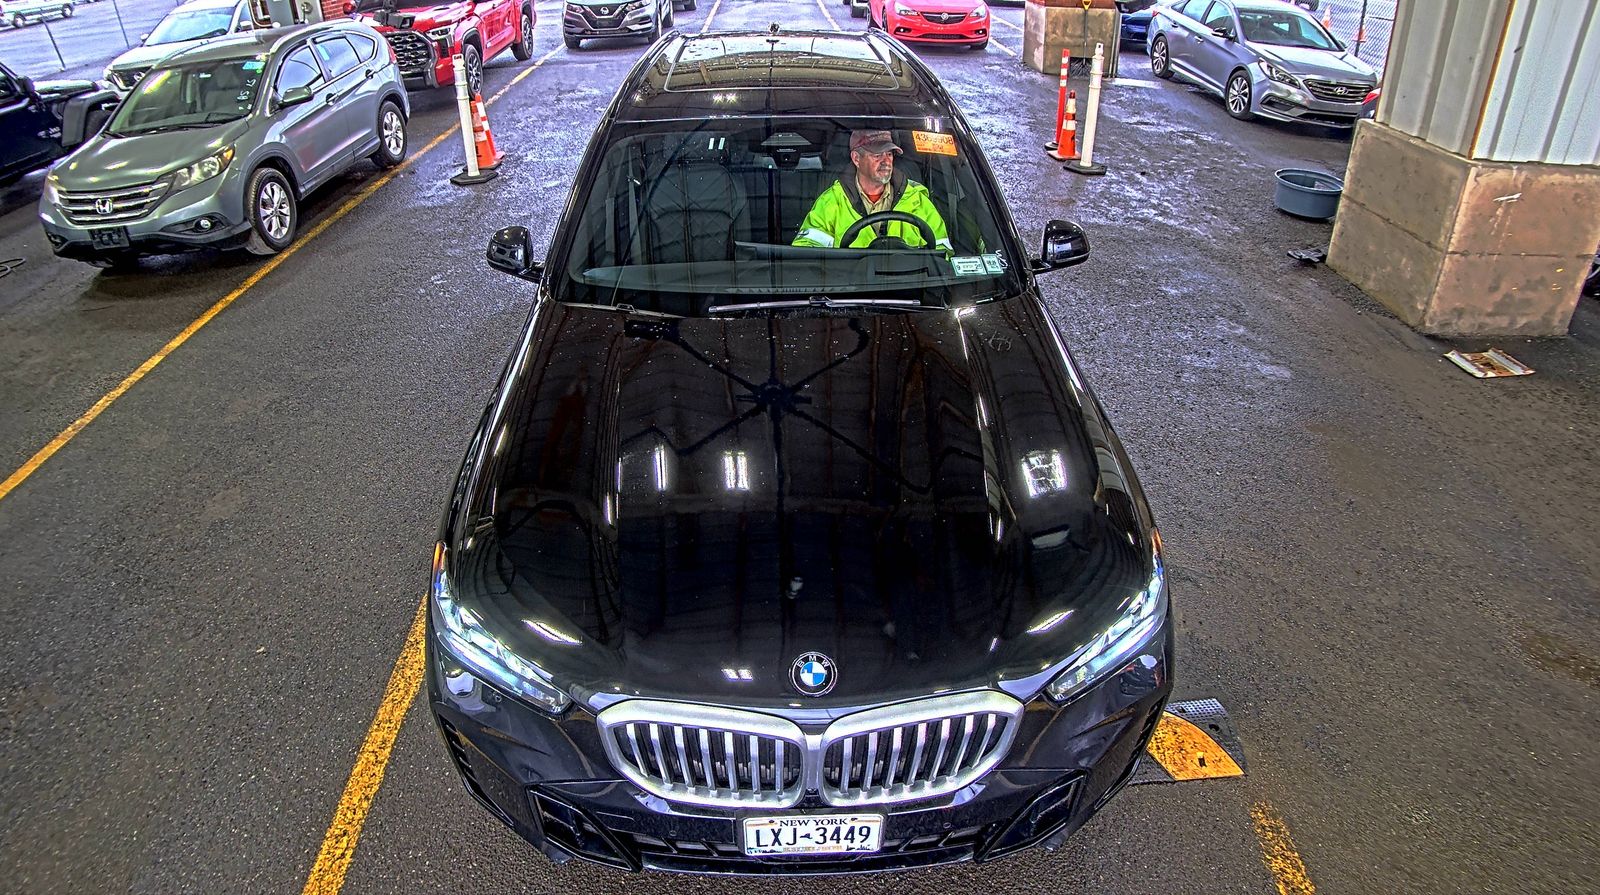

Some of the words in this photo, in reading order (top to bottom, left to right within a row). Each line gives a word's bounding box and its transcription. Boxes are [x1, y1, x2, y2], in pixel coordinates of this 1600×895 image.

[796, 655, 831, 668] BMW
[779, 819, 811, 827] NEW
[813, 817, 849, 826] YORK
